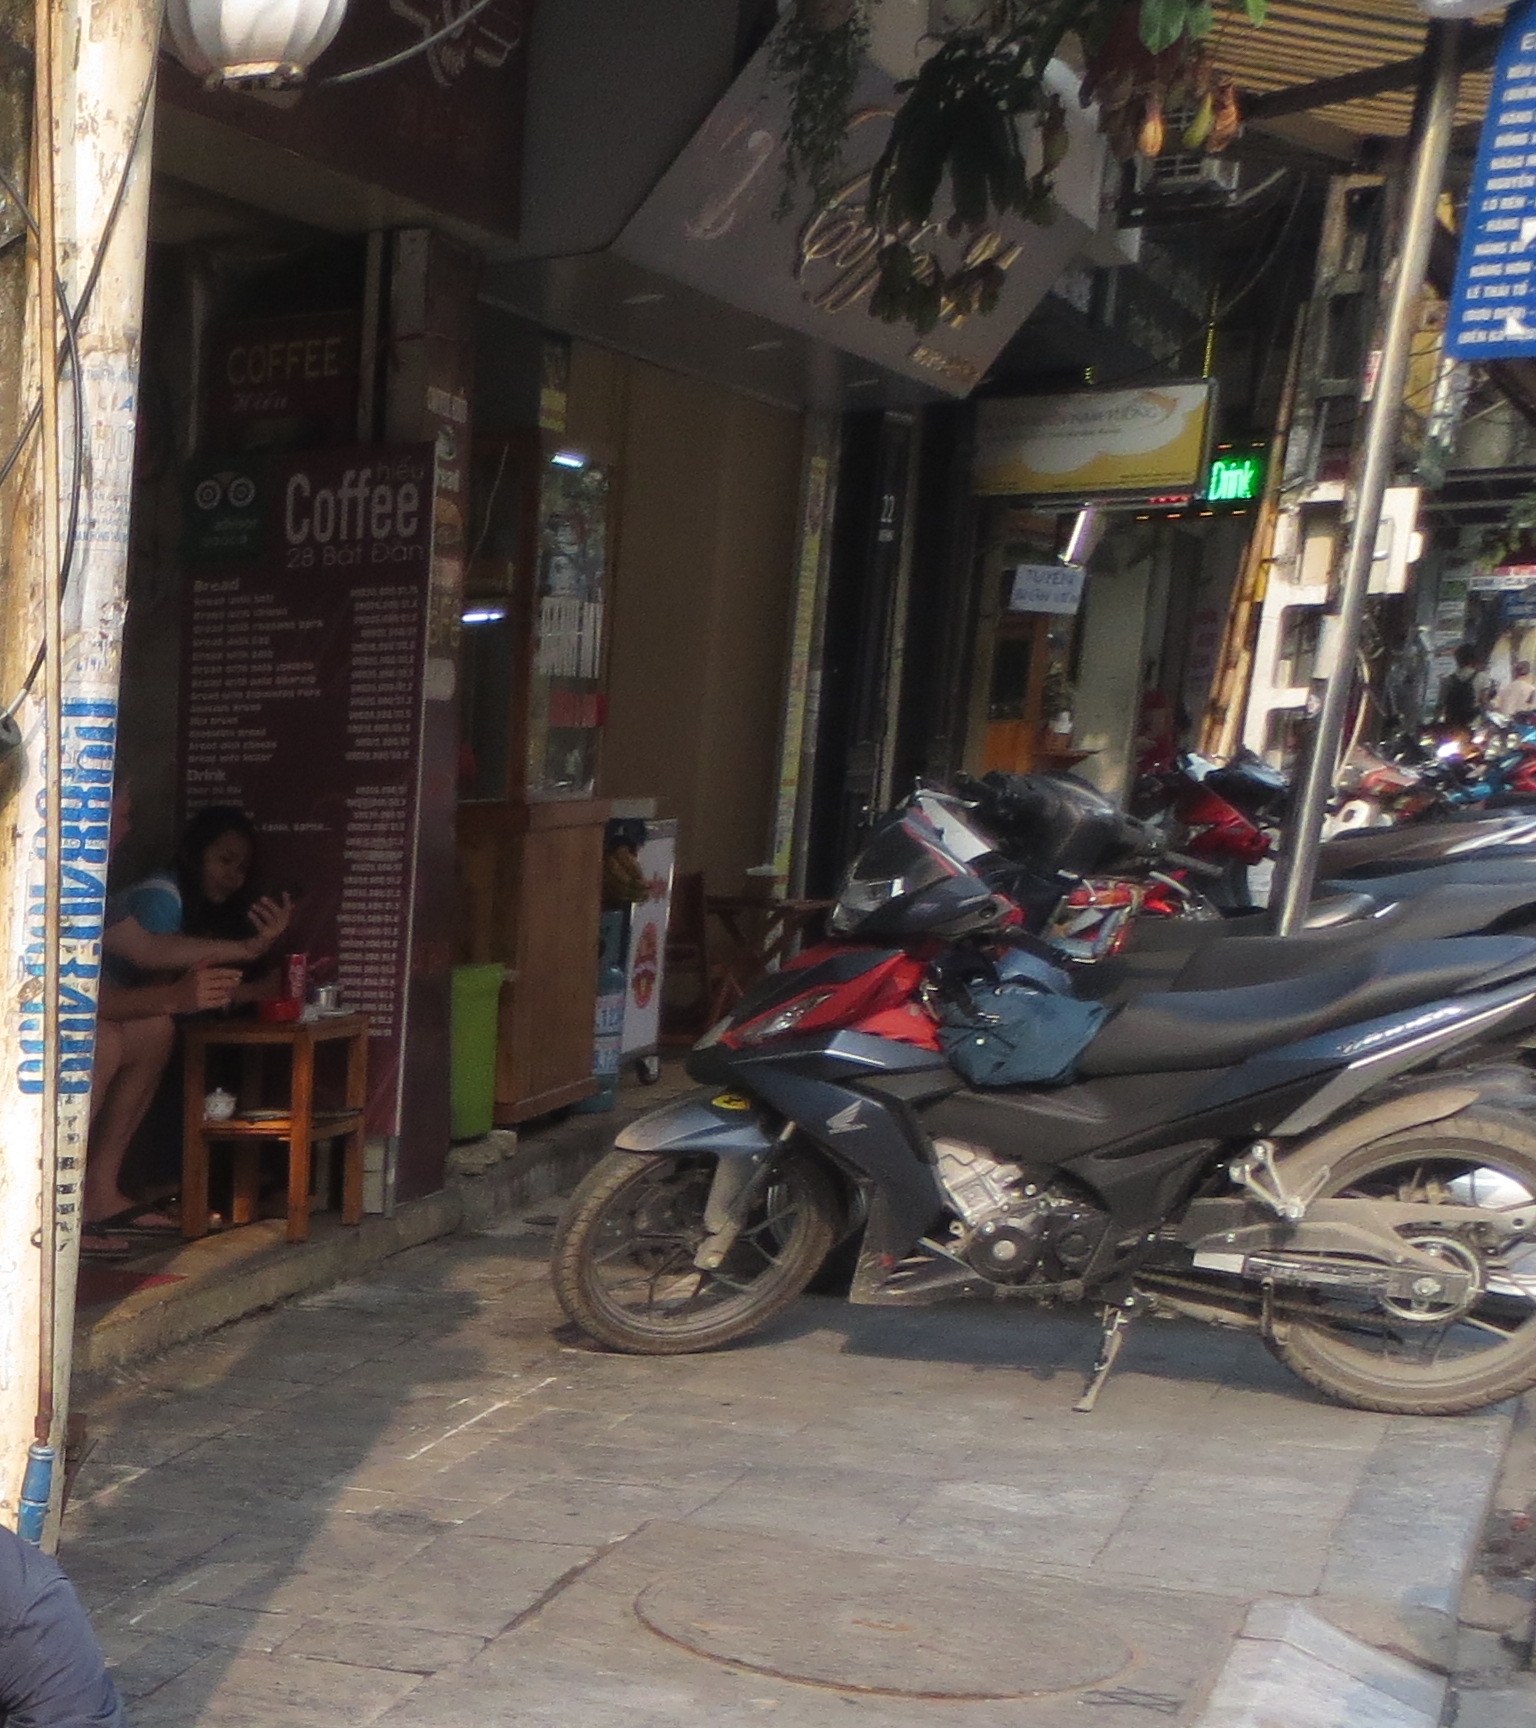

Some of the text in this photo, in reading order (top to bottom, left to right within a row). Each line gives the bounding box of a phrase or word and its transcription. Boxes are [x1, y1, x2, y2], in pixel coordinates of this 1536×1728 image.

[228, 336, 342, 386] COFFEE
[285, 467, 419, 545] Coffee
[286, 547, 315, 568] 28
